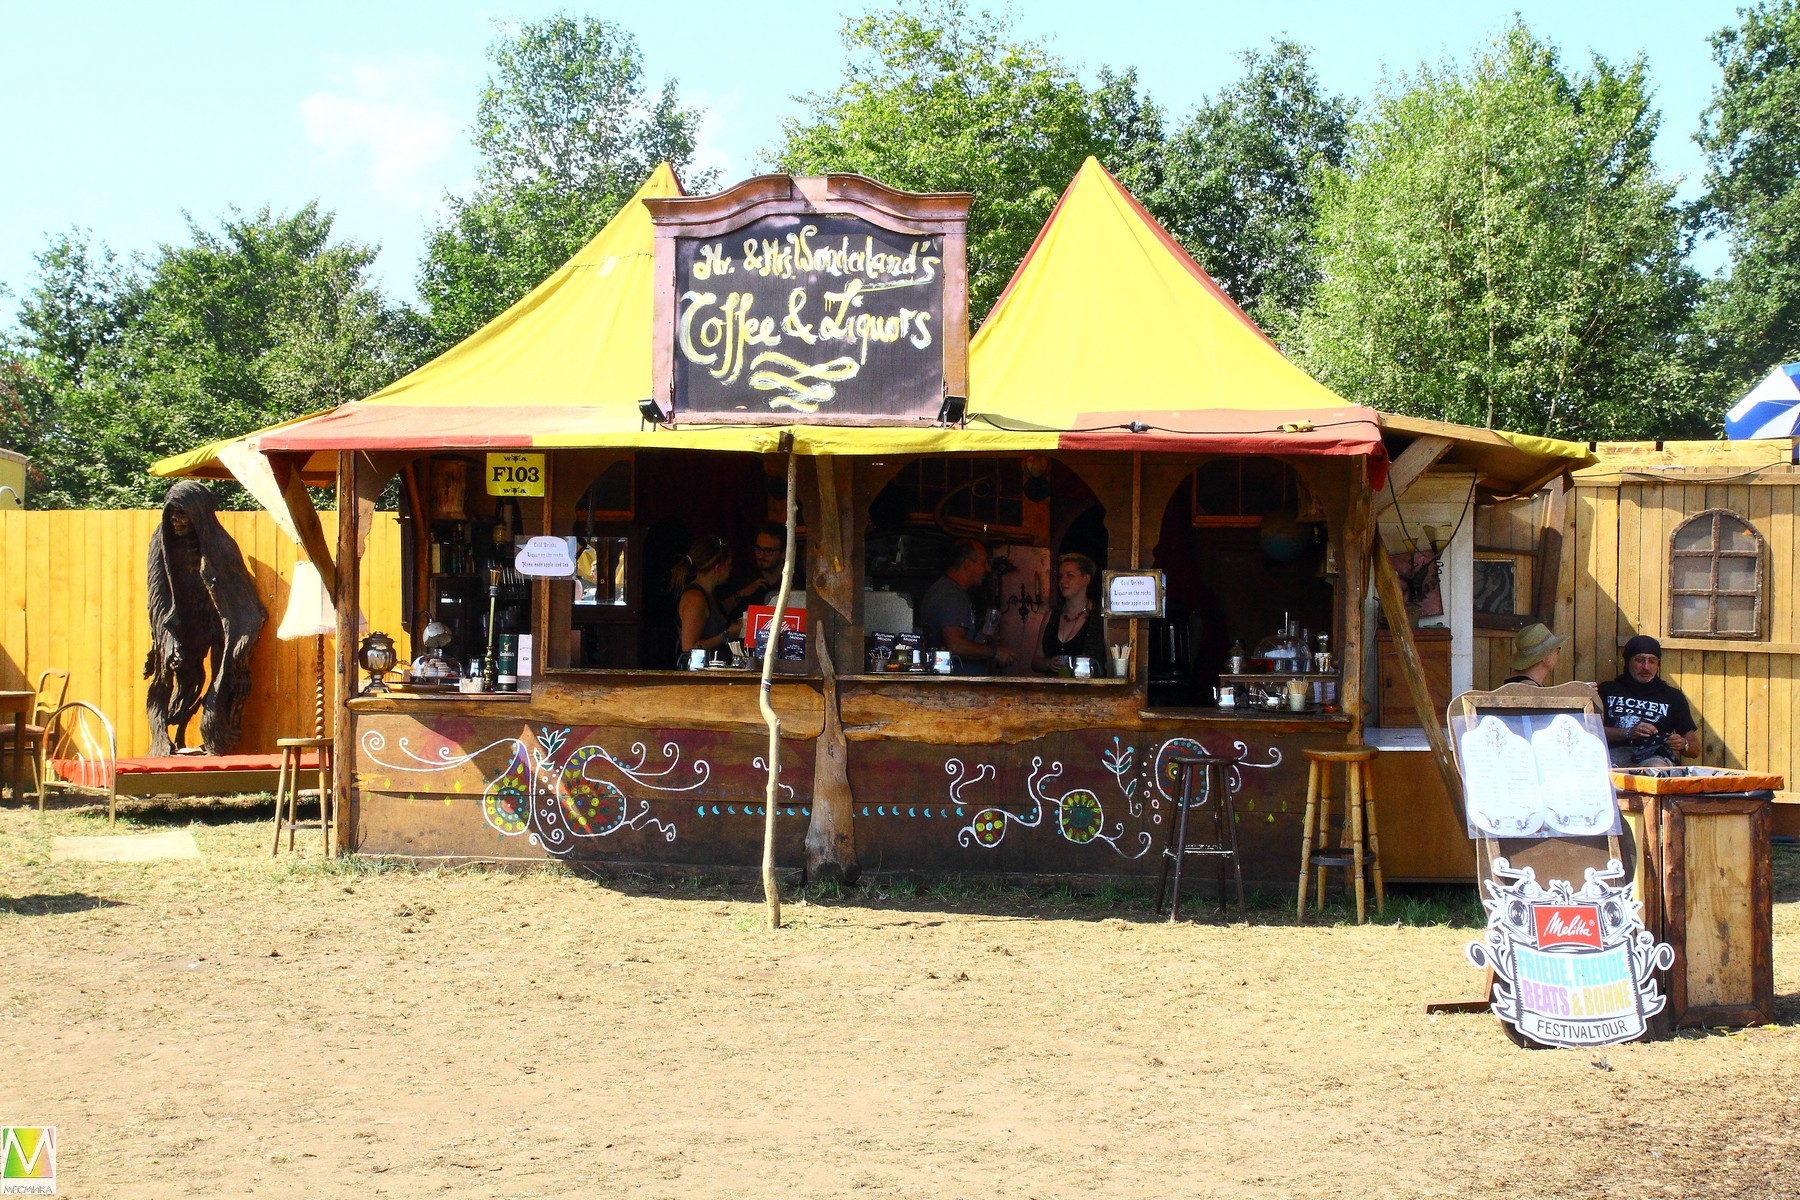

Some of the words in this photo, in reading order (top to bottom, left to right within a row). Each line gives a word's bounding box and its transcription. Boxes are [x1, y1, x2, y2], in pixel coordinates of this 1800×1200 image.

[693, 242, 735, 280] Mr.
[743, 238, 764, 271] &
[679, 291, 782, 385] Coffee
[781, 287, 818, 345] &
[818, 279, 932, 366] Liquors
[491, 466, 540, 483] F103
[1606, 695, 1669, 717] WACKEN
[1516, 951, 1572, 988] FRIEDE,
[1521, 979, 1571, 1017] BEATS
[1570, 992, 1584, 1017] &
[1583, 979, 1632, 1017] BOHNE
[1536, 1019, 1629, 1039] FESTIVALTOUR
